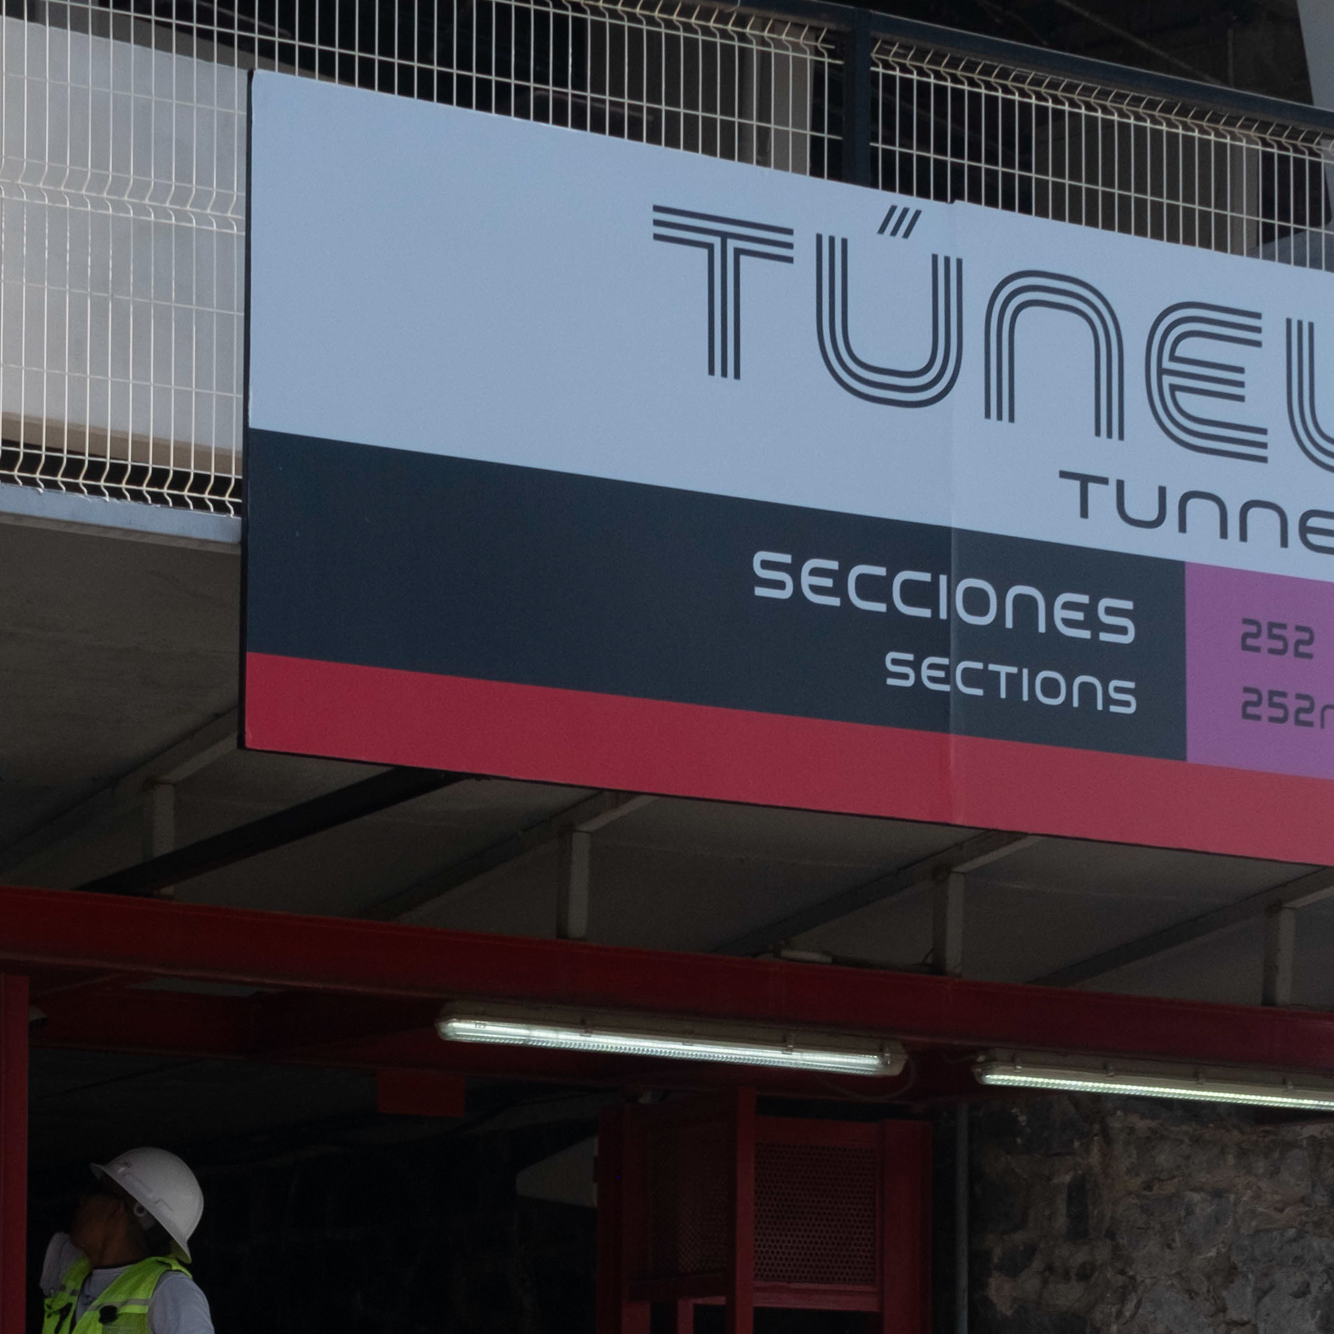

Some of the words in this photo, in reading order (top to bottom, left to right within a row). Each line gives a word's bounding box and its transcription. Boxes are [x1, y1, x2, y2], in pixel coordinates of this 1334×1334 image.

[753, 550, 1136, 644] SECCIONES
[1240, 618, 1315, 660] 252
[884, 651, 1137, 715] SECTIONS
